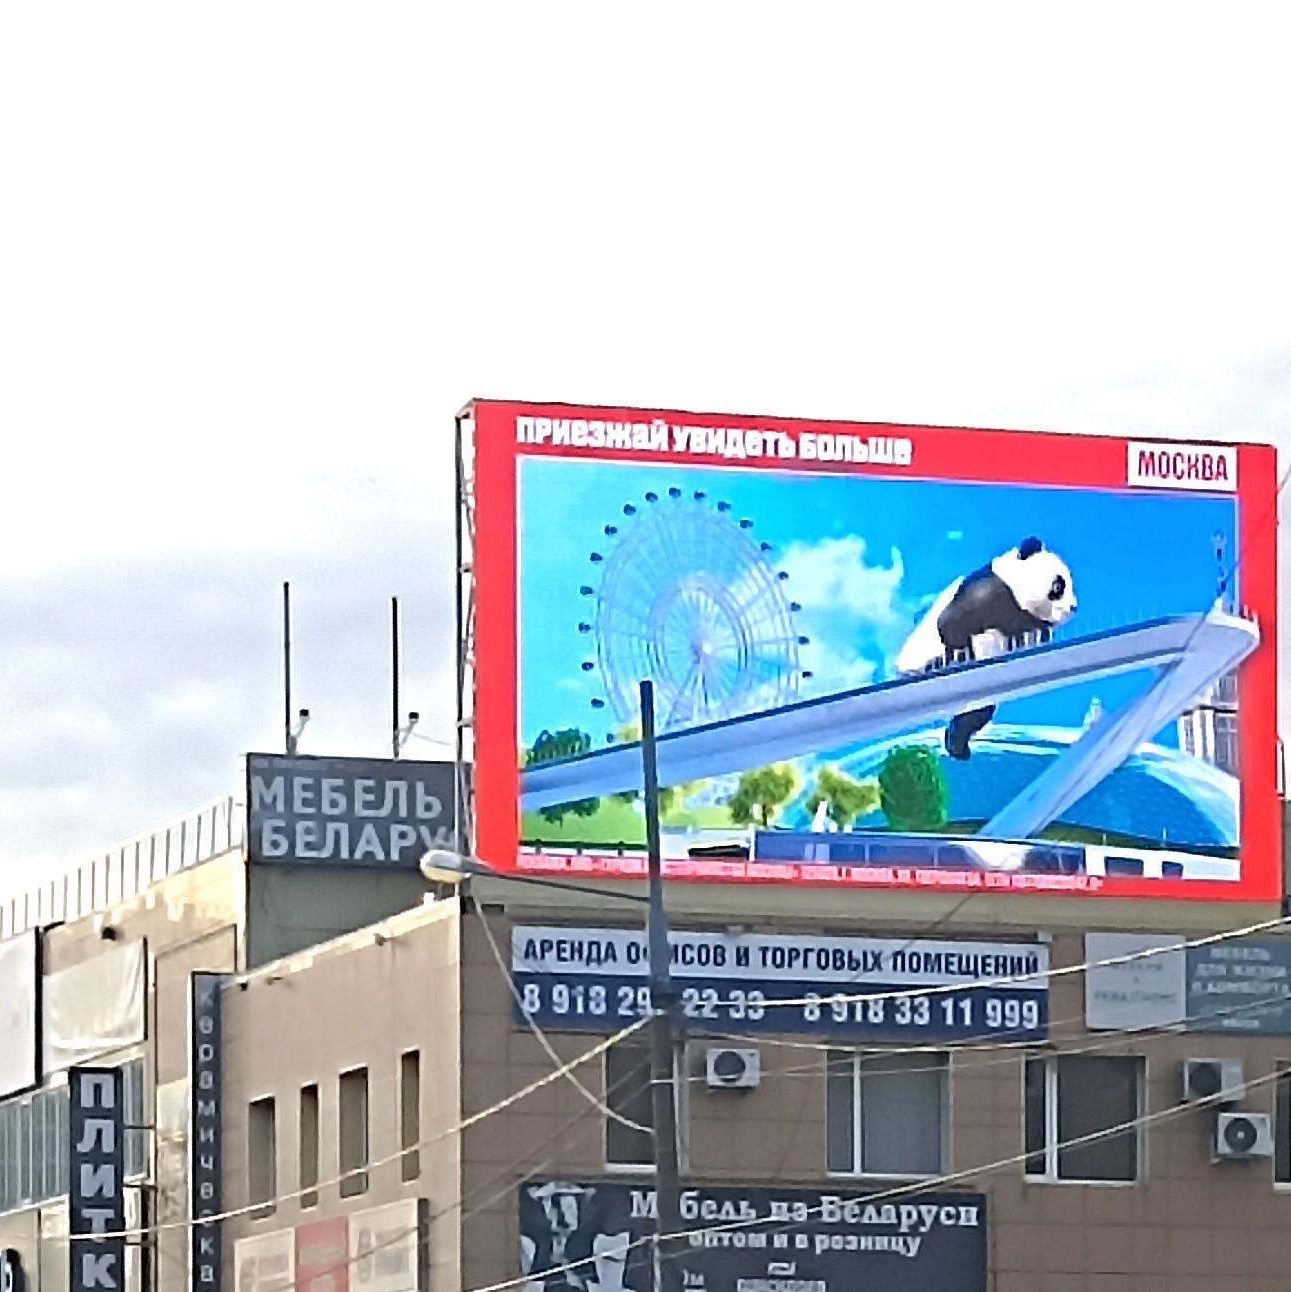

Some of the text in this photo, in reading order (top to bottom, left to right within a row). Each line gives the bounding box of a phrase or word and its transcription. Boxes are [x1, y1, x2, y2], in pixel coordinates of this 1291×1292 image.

[1137, 450, 1229, 481] МОСКВА
[251, 775, 443, 819] МЕБЕЛЬ
[523, 938, 618, 966] АРЕНДА
[735, 945, 750, 967] И
[760, 945, 883, 973] ТОРГОВЫХ
[892, 950, 1039, 978] ПОМЕЩЕНИЙ
[523, 983, 541, 1014] 8
[552, 983, 607, 1015] 918
[682, 988, 719, 1019] 22
[728, 989, 765, 1020] 33
[803, 992, 821, 1022] 8
[831, 993, 885, 1024] 918
[895, 996, 930, 1026] 33
[940, 997, 972, 1027] 11
[985, 999, 1039, 1030] 999
[629, 1189, 757, 1220] Мбель
[814, 1233, 922, 1258] розницу
